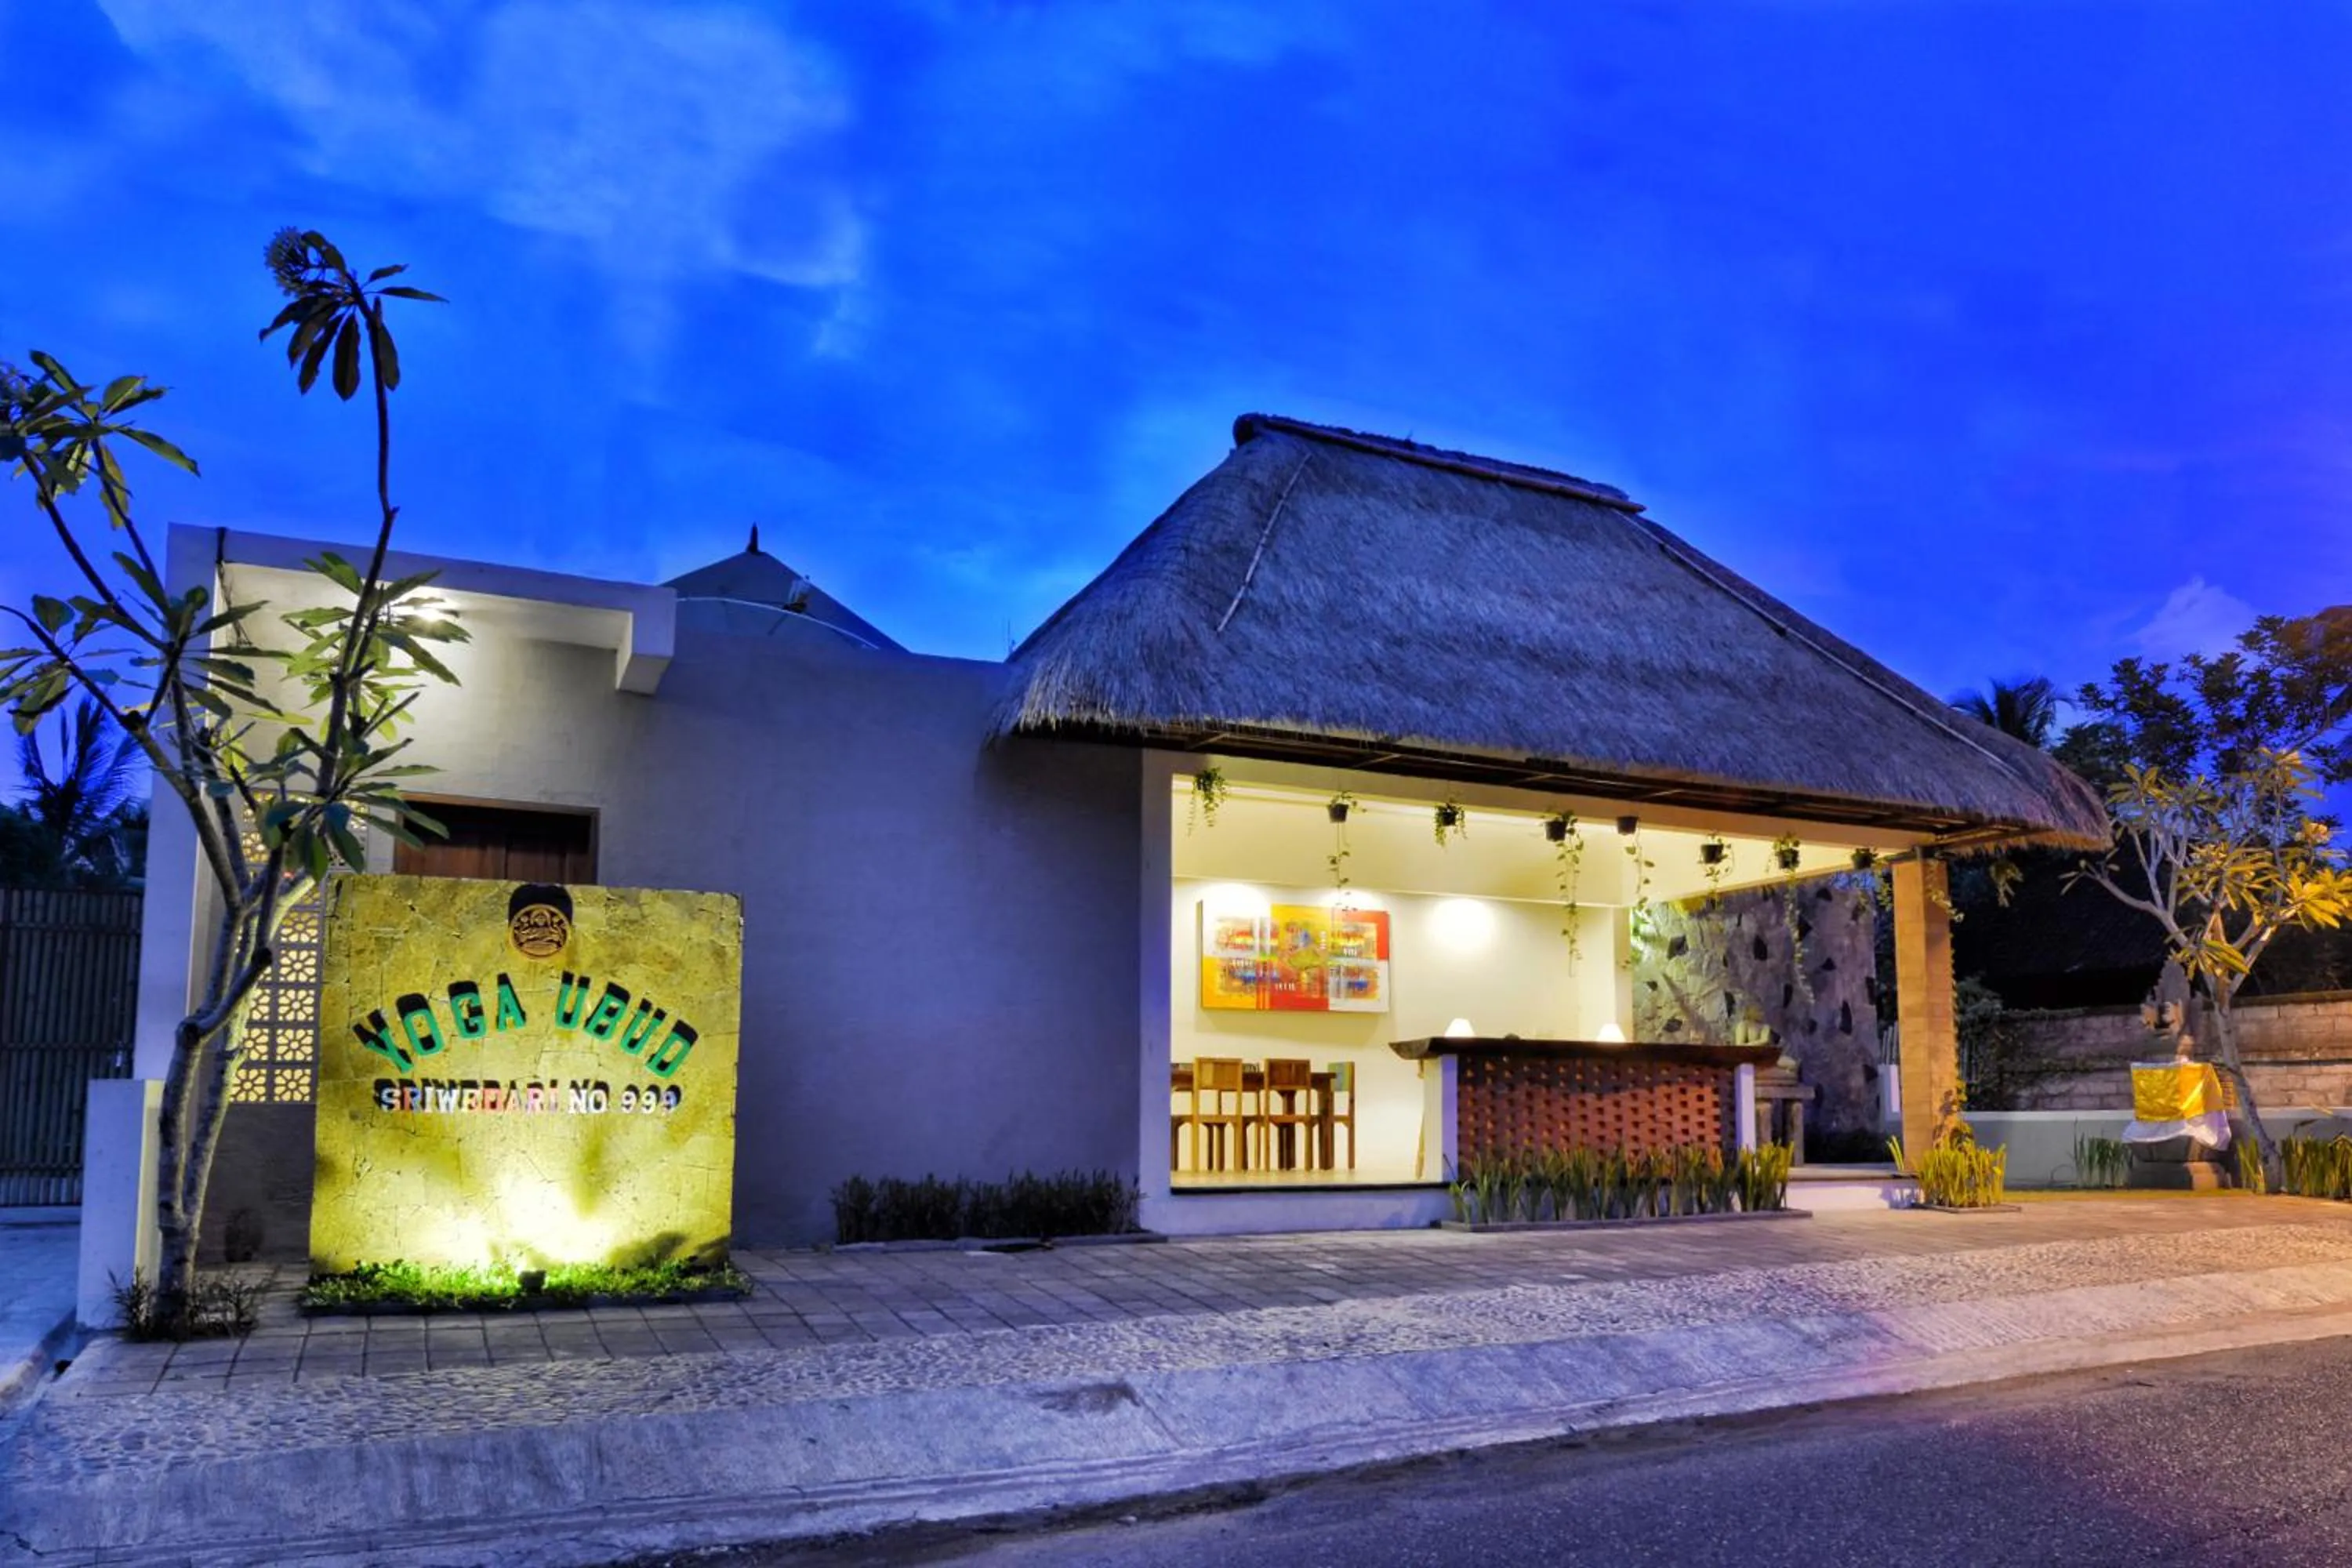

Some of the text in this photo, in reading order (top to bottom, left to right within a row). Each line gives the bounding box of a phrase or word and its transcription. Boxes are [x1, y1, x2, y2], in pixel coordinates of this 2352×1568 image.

[354, 973, 698, 1079] YOGA UBUD
[376, 1082, 680, 1114] SRIWEDARI NO 999
